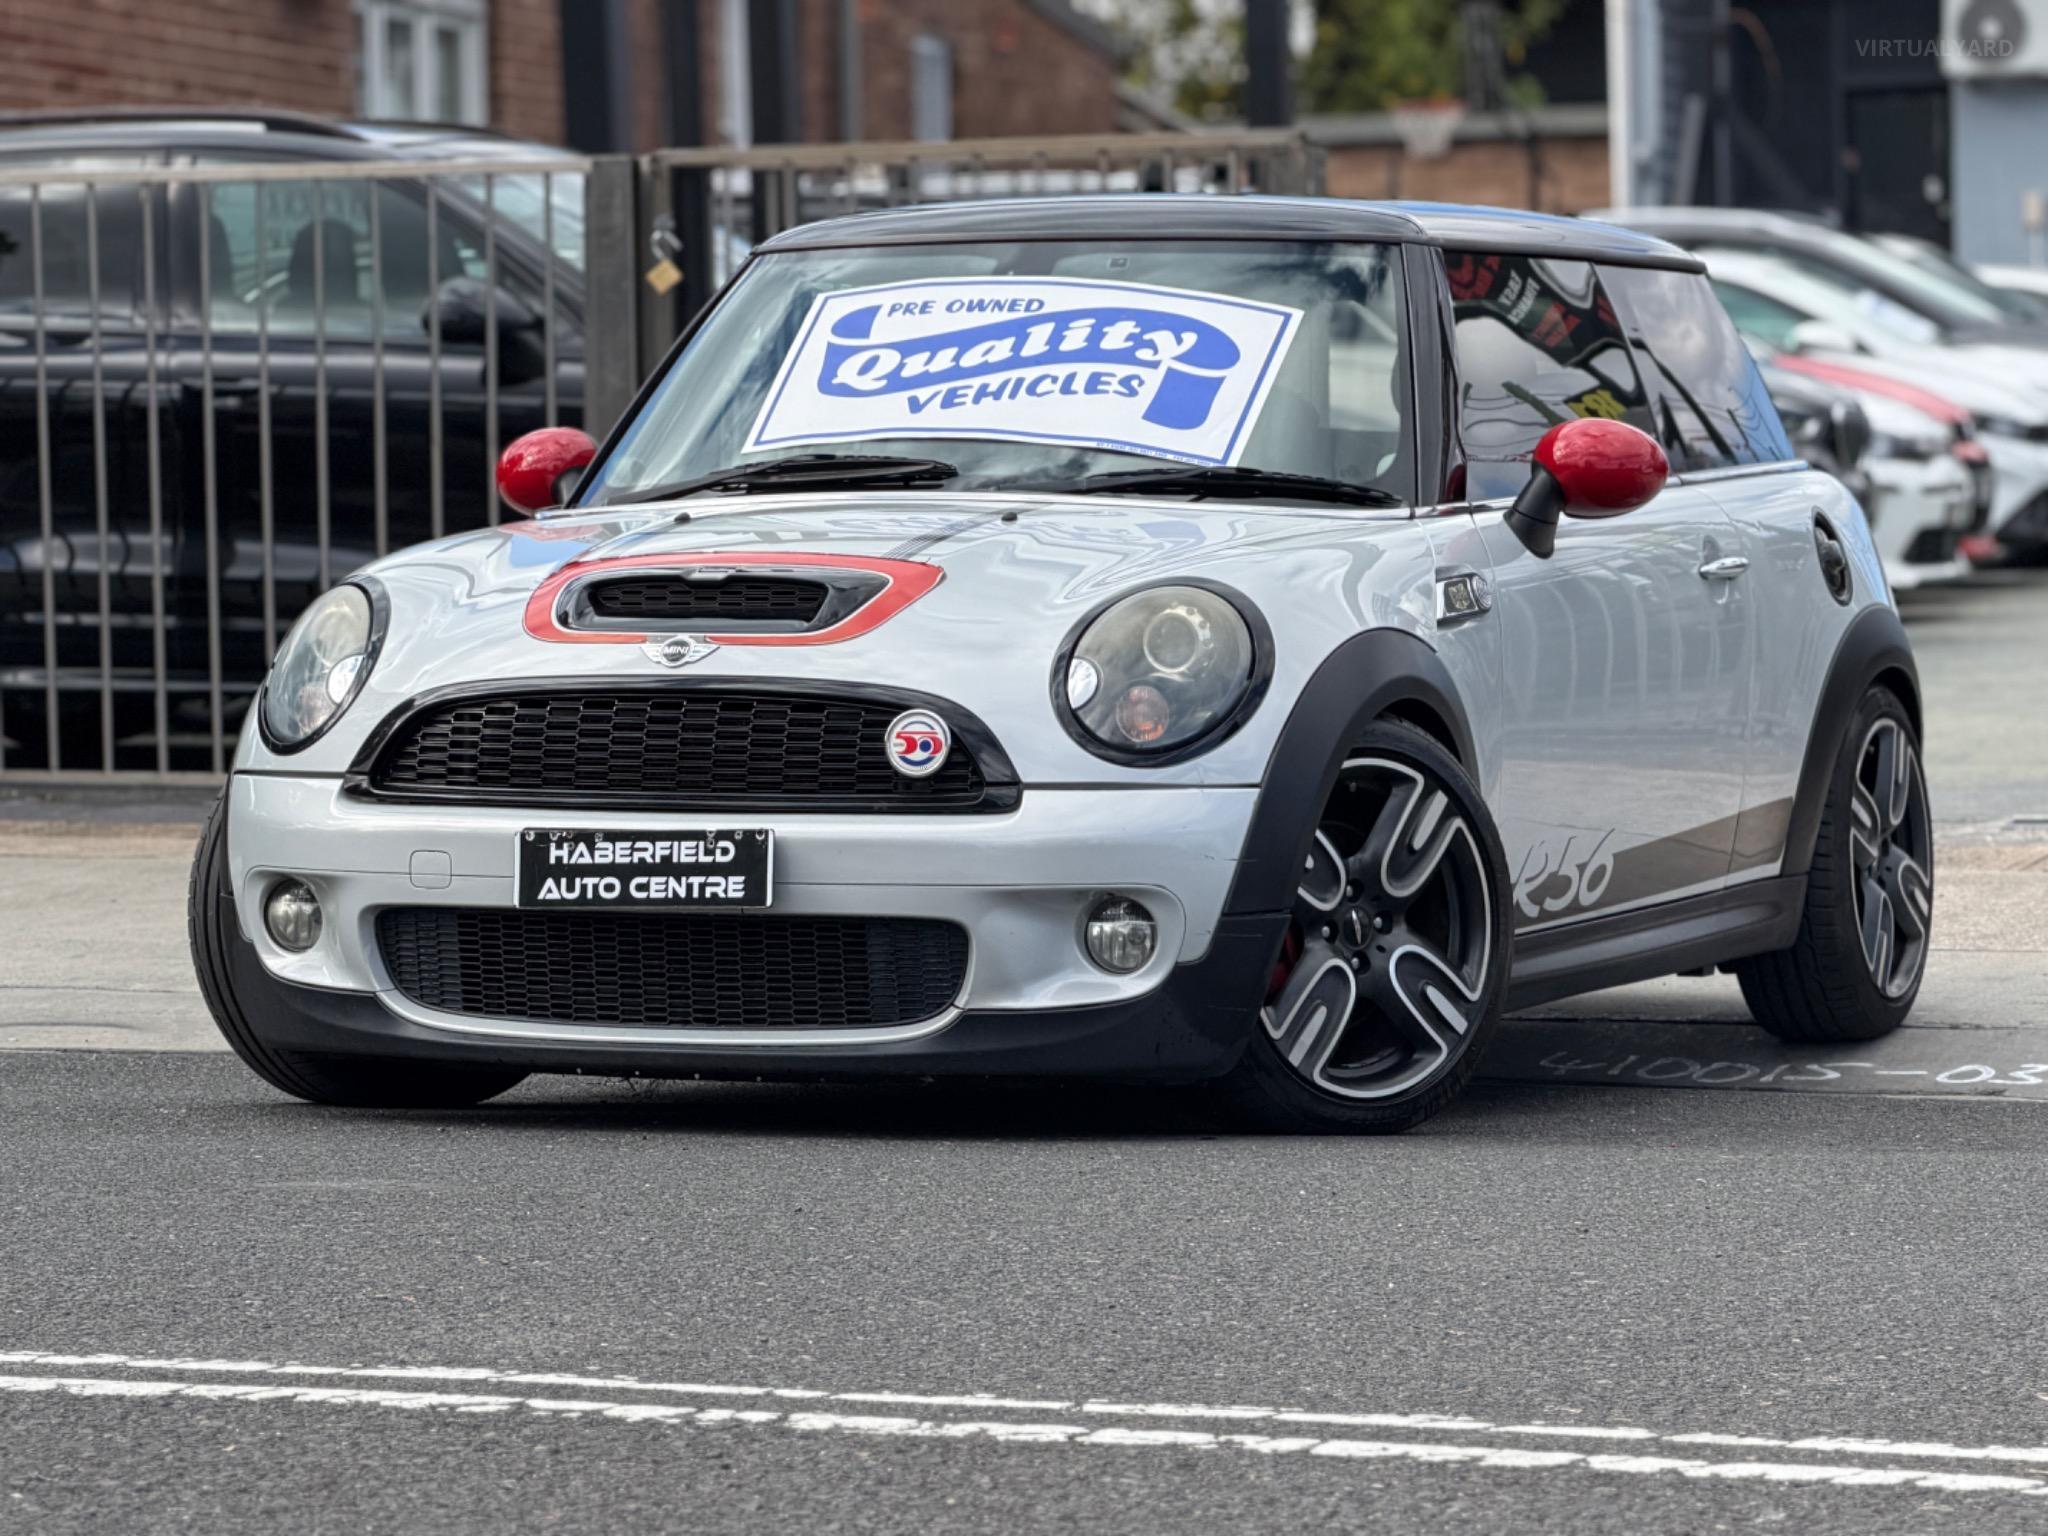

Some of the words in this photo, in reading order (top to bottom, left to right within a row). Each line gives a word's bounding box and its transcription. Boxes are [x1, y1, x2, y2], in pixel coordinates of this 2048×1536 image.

[887, 300, 937, 318] PRE
[945, 298, 1045, 314] OWNED
[831, 318, 1198, 391] Quality
[907, 371, 1145, 414] VEHICLES
[663, 645, 690, 655] MINI
[549, 841, 736, 865] HABERFIELD
[1513, 827, 1616, 918] R56
[537, 876, 622, 900] AUTO
[629, 875, 746, 899] CENTRE
